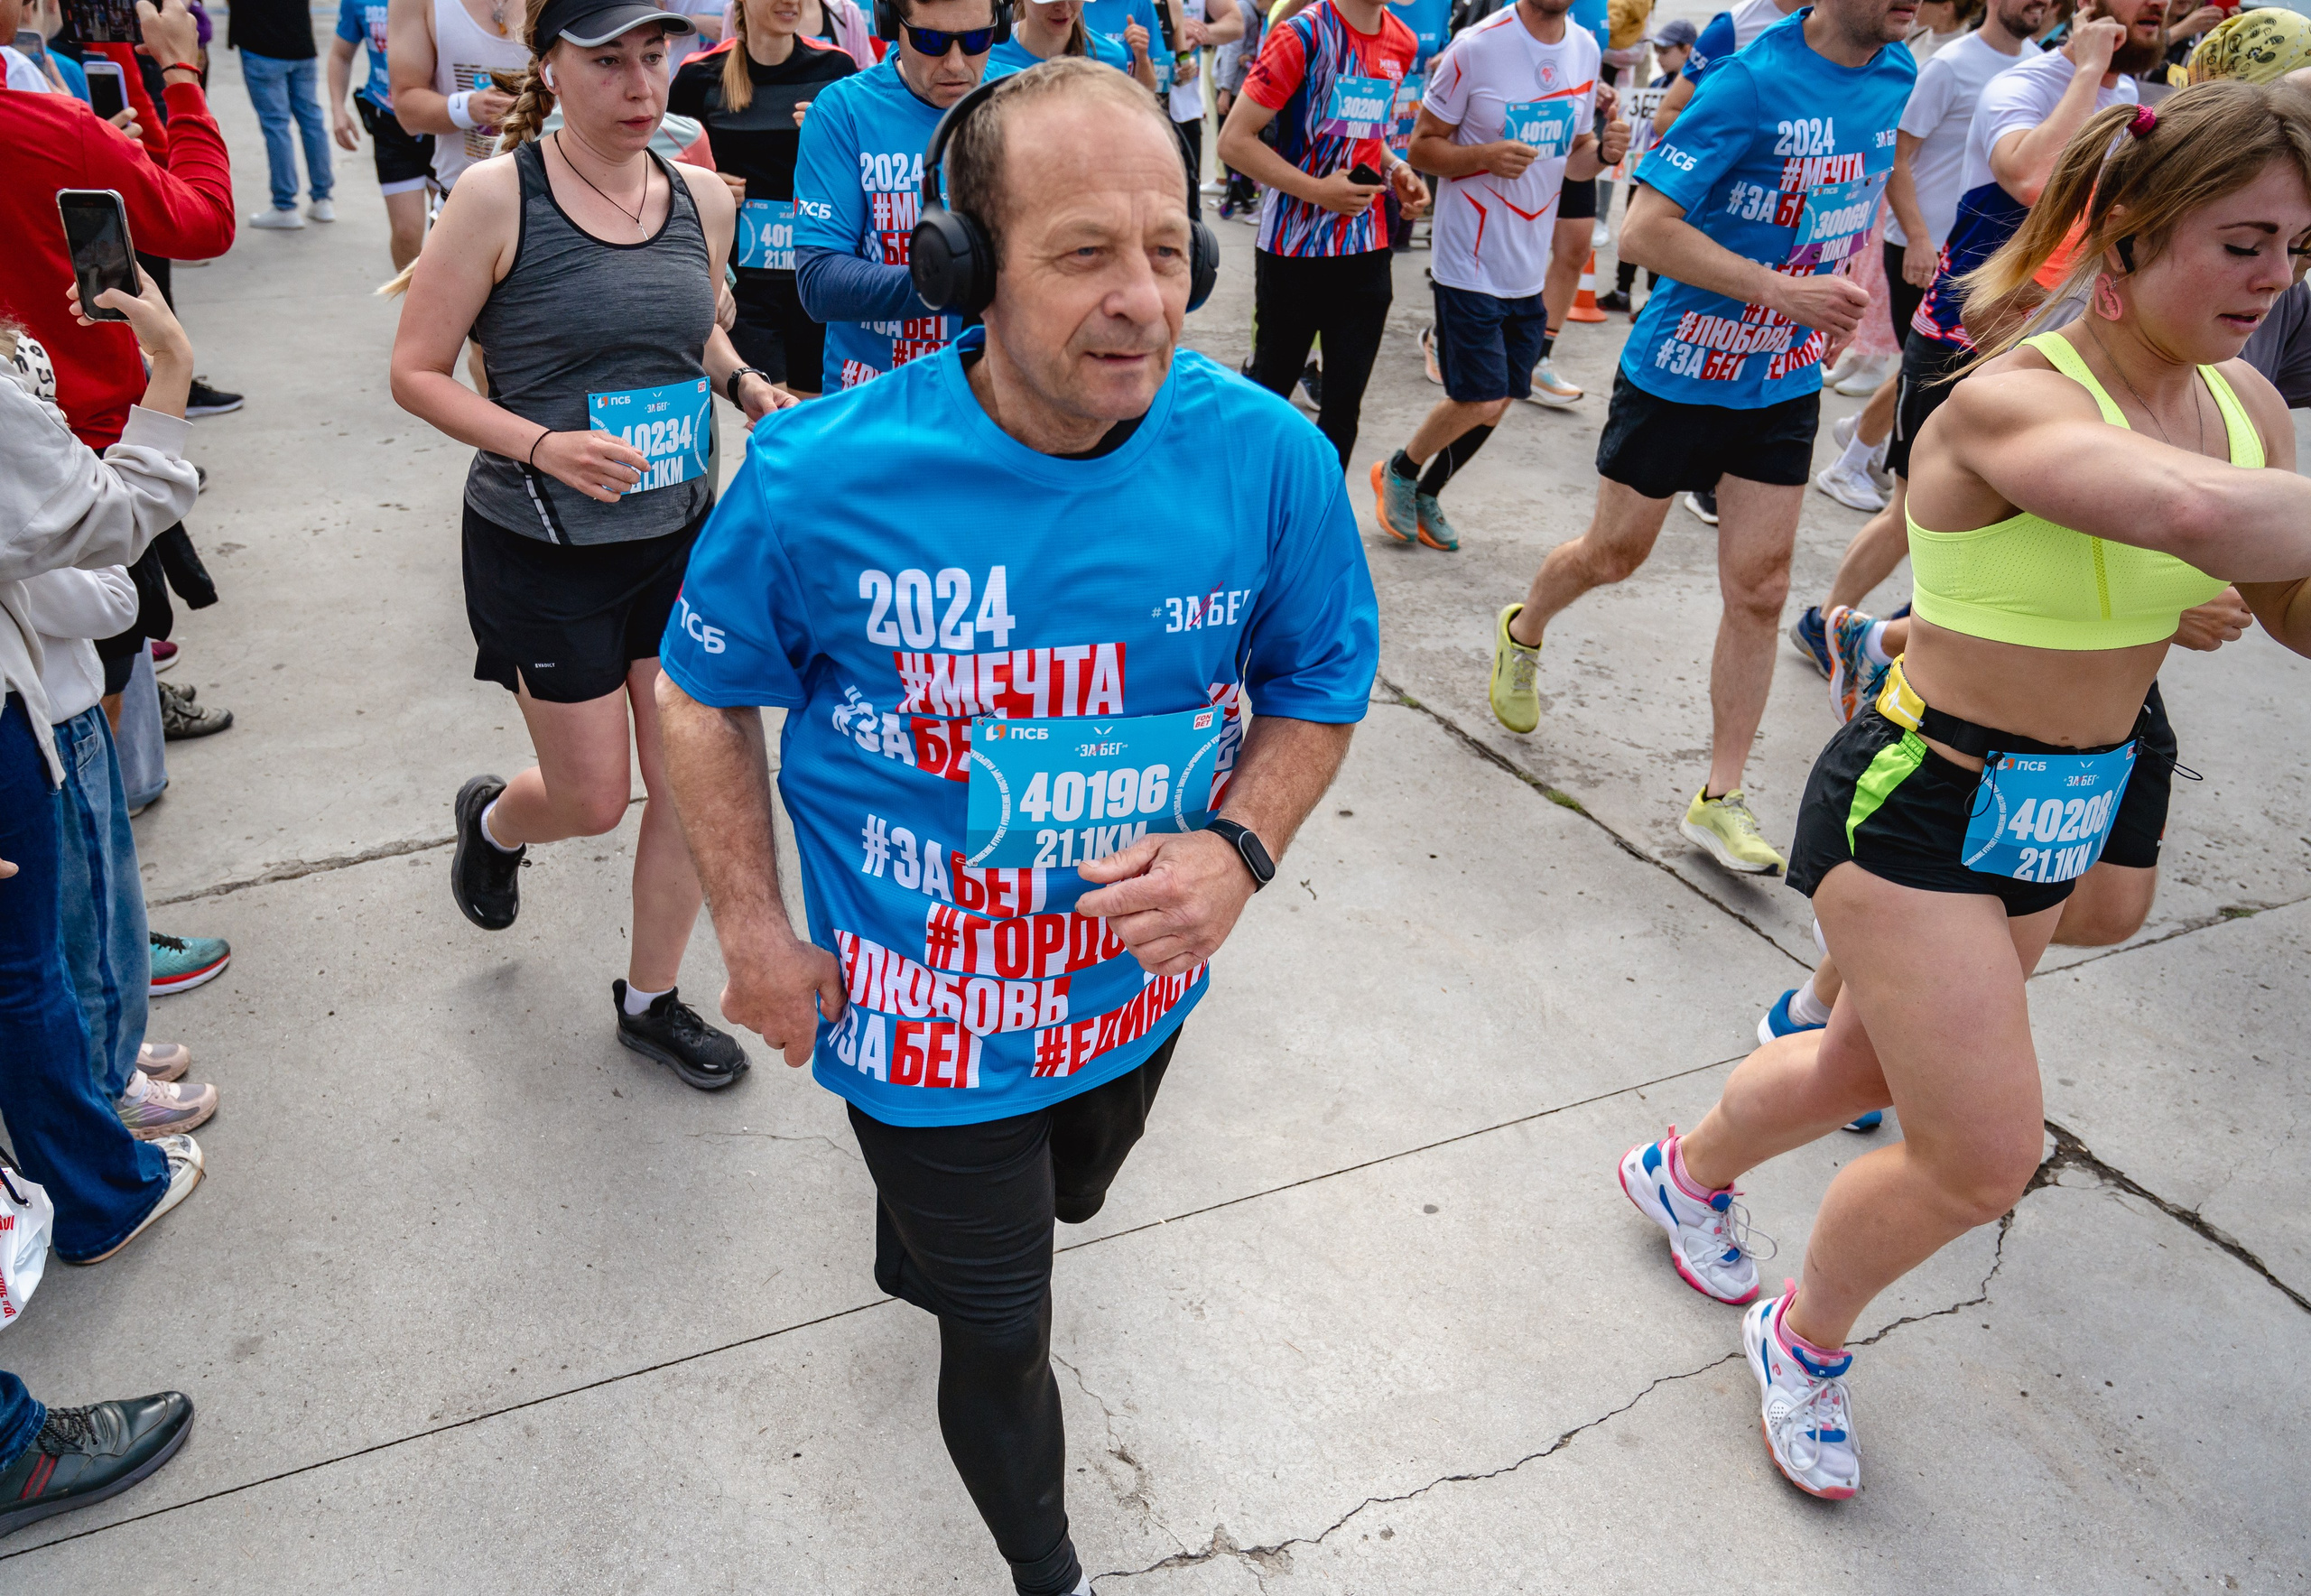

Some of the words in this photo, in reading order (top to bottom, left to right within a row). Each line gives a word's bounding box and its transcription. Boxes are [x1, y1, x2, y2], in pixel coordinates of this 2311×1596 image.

[1341, 96, 1384, 121] 30200
[1519, 119, 1564, 143] 40170
[1774, 116, 1835, 156] 2024
[860, 152, 924, 191] 2024
[1659, 143, 1698, 172] ПСБ
[1726, 181, 1805, 228] #ЗАБЕ
[1814, 200, 1870, 239] 30069
[760, 223, 794, 248] 401
[1675, 311, 1794, 354] #ЛЮБОВЬ
[611, 396, 631, 405] ПСБ
[621, 415, 692, 459] 40234
[859, 565, 1016, 651] 2024
[894, 643, 1125, 719] #МЕЧТА
[832, 684, 972, 784] #ЗАБЕ
[1010, 727, 1049, 740] ПСБ
[1195, 719, 1211, 728] BET
[1196, 713, 1212, 722] FON
[2017, 761, 2046, 771] ПСБ
[1019, 764, 1170, 822] 40196
[2008, 790, 2113, 843] 40208
[925, 904, 1126, 979] #ГОРДО
